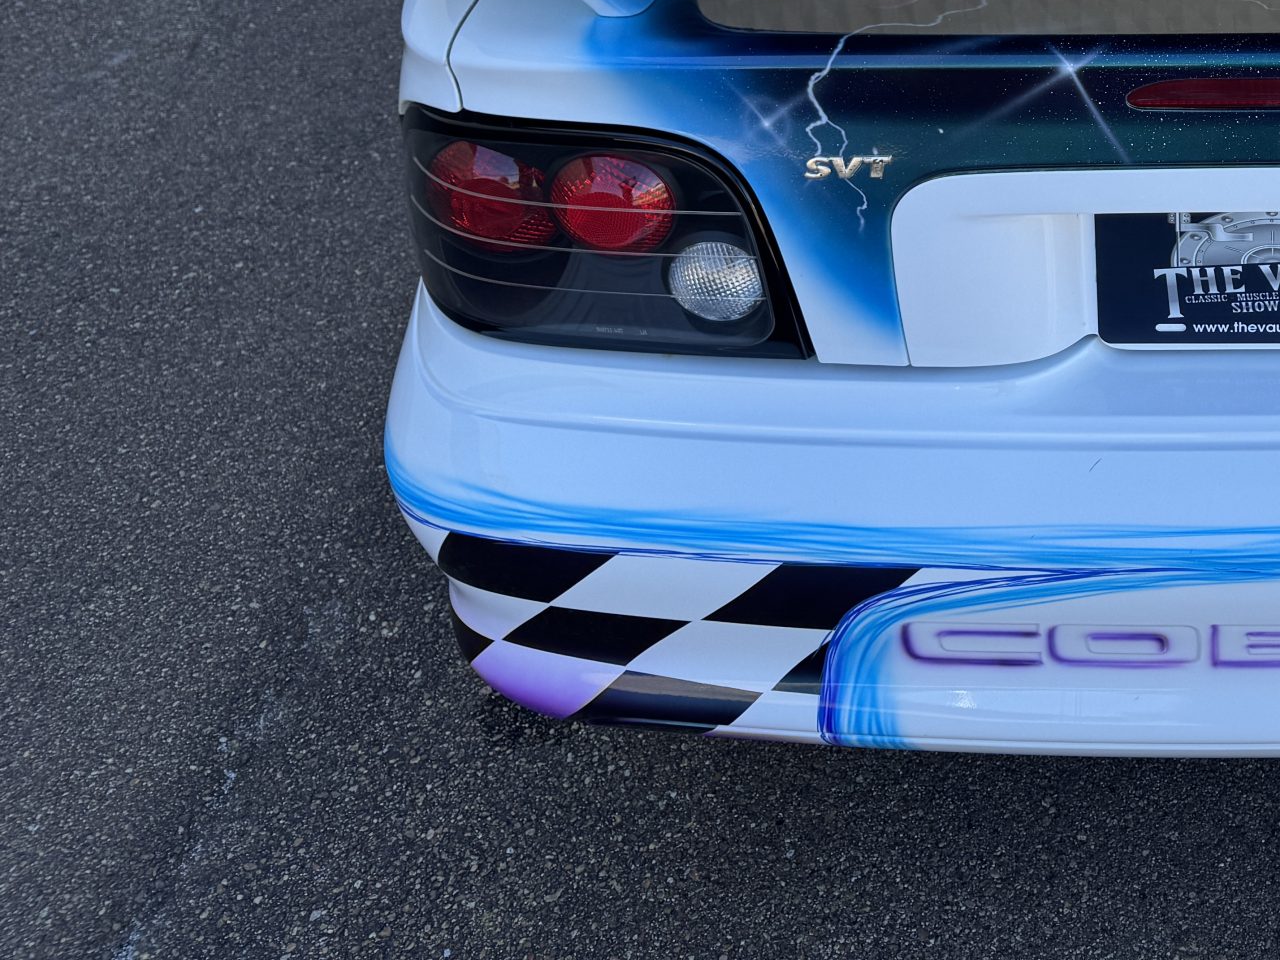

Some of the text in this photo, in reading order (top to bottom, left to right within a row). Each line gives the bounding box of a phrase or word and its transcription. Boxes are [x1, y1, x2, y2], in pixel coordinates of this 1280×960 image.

[804, 155, 892, 179] SVT
[1153, 266, 1245, 319] THE
[1185, 294, 1228, 303] CLASSIC
[1237, 291, 1280, 301] MUSCLE
